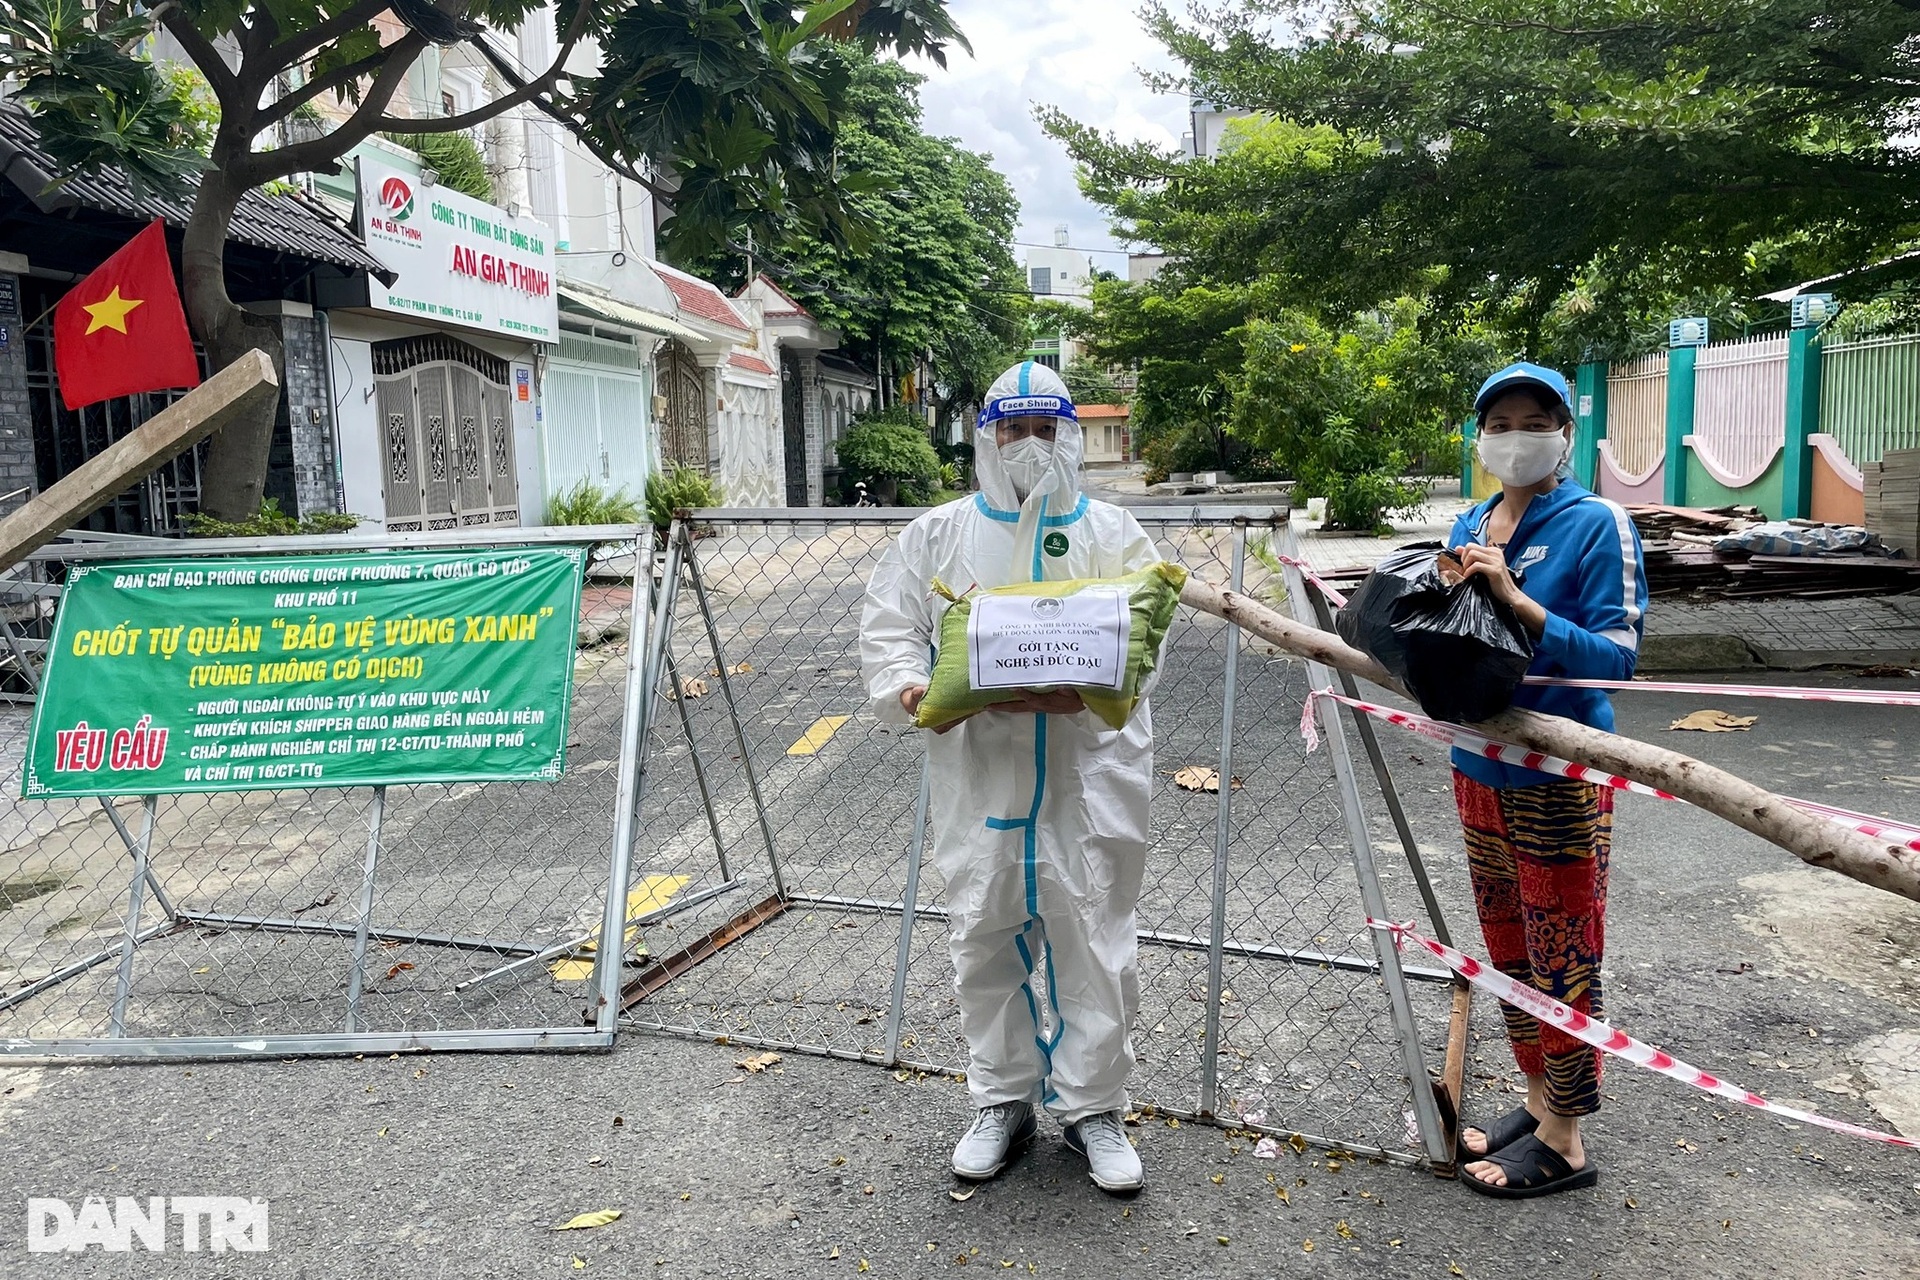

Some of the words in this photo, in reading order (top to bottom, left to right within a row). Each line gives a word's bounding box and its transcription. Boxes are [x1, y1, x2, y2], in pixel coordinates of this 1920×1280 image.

[371, 217, 382, 230] AN
[385, 221, 398, 234] GIA
[400, 226, 422, 241] THỊNH
[432, 200, 455, 226] CÔNG
[458, 211, 467, 230] TY
[470, 216, 491, 238] TNHH
[494, 219, 507, 244] BẤT
[510, 228, 528, 251] ĐỘNG
[530, 234, 544, 256] SẢN
[452, 244, 477, 277] AN
[481, 253, 507, 285] GIA
[509, 261, 550, 297] THỊNH
[1522, 546, 1549, 559] NIKE
[114, 574, 144, 588] BAN
[147, 568, 173, 588] CHỈ
[174, 571, 203, 590] ĐẠO
[207, 568, 256, 586] PHÒNG
[260, 565, 309, 584] CHỐNG
[313, 566, 348, 585] DỊCH
[351, 563, 411, 580] PHƯỜNG
[415, 564, 428, 580] 7,
[432, 558, 473, 580] QUẬN
[478, 558, 497, 575] GÒ
[502, 556, 530, 574] VẤP
[274, 593, 306, 608] KHU
[307, 587, 339, 606] PHỐ
[341, 591, 358, 605] 11
[72, 620, 142, 656] CHỐT
[149, 624, 185, 660] TỰ
[187, 617, 262, 656] QUẢN
[344, 616, 376, 653] VỆ
[385, 614, 456, 646] VÙNG
[1044, 642, 1079, 653] TẶNG
[189, 661, 253, 688] (VÙNG
[257, 657, 327, 684] KHÔNG
[333, 655, 361, 680] CÓ
[366, 657, 423, 683] DỊCH)
[995, 656, 1030, 669] NGHỆ
[1033, 655, 1044, 667] SĨ
[1048, 654, 1074, 666] ĐỨC
[197, 699, 239, 715] NGƯỜI
[242, 697, 284, 713] NGOÀI
[287, 694, 333, 711] KHÔNG
[337, 694, 357, 713] TỰ
[358, 693, 368, 708] Ý
[370, 692, 396, 708] VÀO
[399, 692, 428, 706] KHU
[431, 690, 458, 708] VỰC
[461, 687, 490, 703] NÀY
[194, 719, 248, 737] KHUYẾN
[251, 718, 292, 735] KHÍCH
[294, 717, 353, 733] SHIPPER
[356, 716, 388, 730] GIAO
[392, 712, 430, 729] HÀNG
[433, 710, 462, 727] BÊN
[466, 708, 509, 726] NGOÀI
[512, 706, 545, 724] HẺM
[54, 721, 106, 772] YÊU
[109, 714, 169, 771] CẦU
[190, 741, 227, 760] CHẤP
[230, 742, 268, 758] HÀNH
[270, 739, 325, 756] NGHIÊM
[328, 735, 353, 753] CHỈ
[356, 739, 377, 755] THỊ
[380, 732, 492, 751] 12-CT/TU-THÀNH
[496, 728, 526, 747] PHỐ
[184, 765, 201, 781] VÀ
[205, 762, 231, 781] CHỈ
[233, 766, 254, 782] THỊ
[258, 763, 323, 779] 16/CT-TTg
